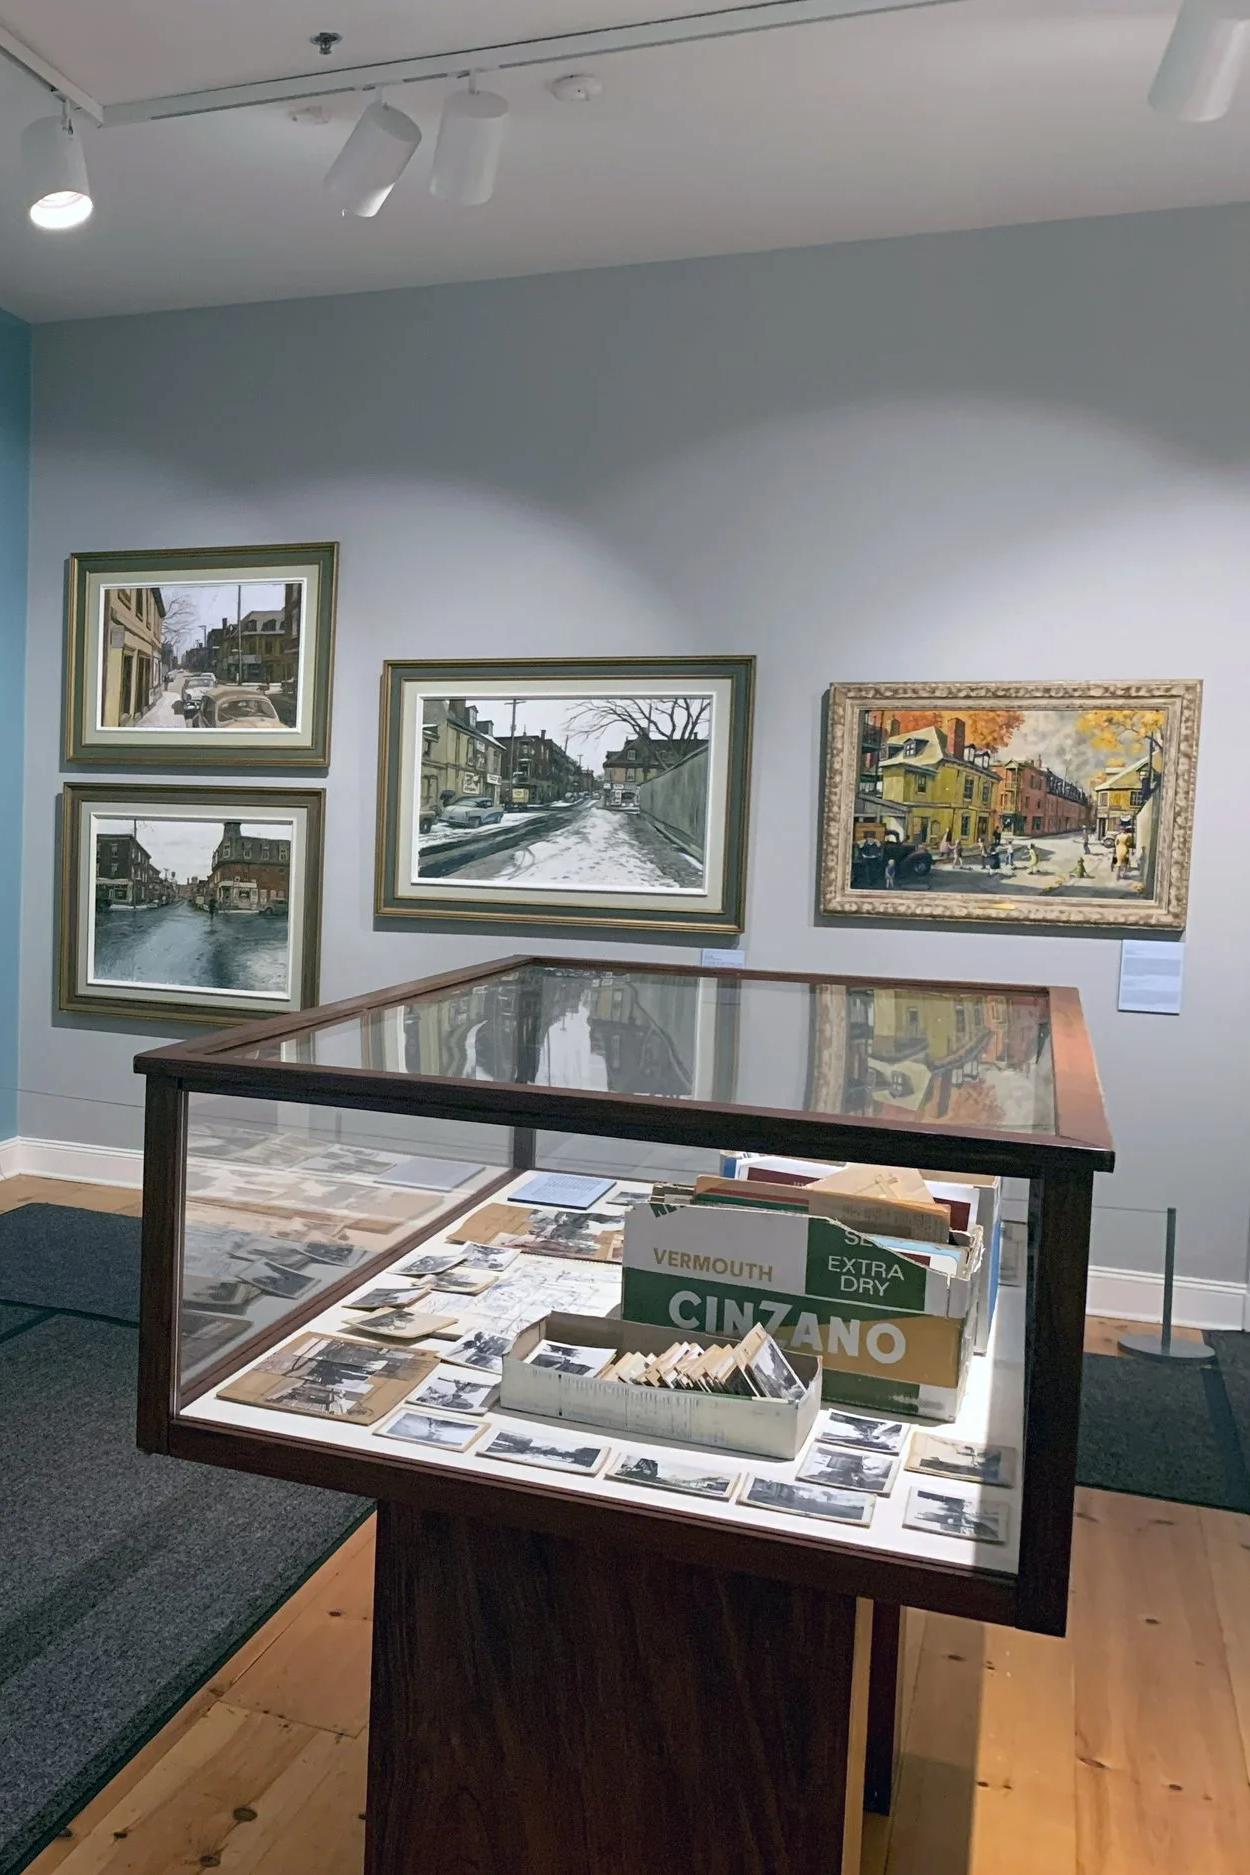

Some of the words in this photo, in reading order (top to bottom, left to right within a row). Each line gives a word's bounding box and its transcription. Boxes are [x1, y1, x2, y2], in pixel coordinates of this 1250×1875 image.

[653, 1247, 773, 1282] VERMOUTH
[827, 1255, 905, 1281] EXTRA
[840, 1275, 890, 1297] DRY
[668, 1290, 907, 1365] CINZANO
